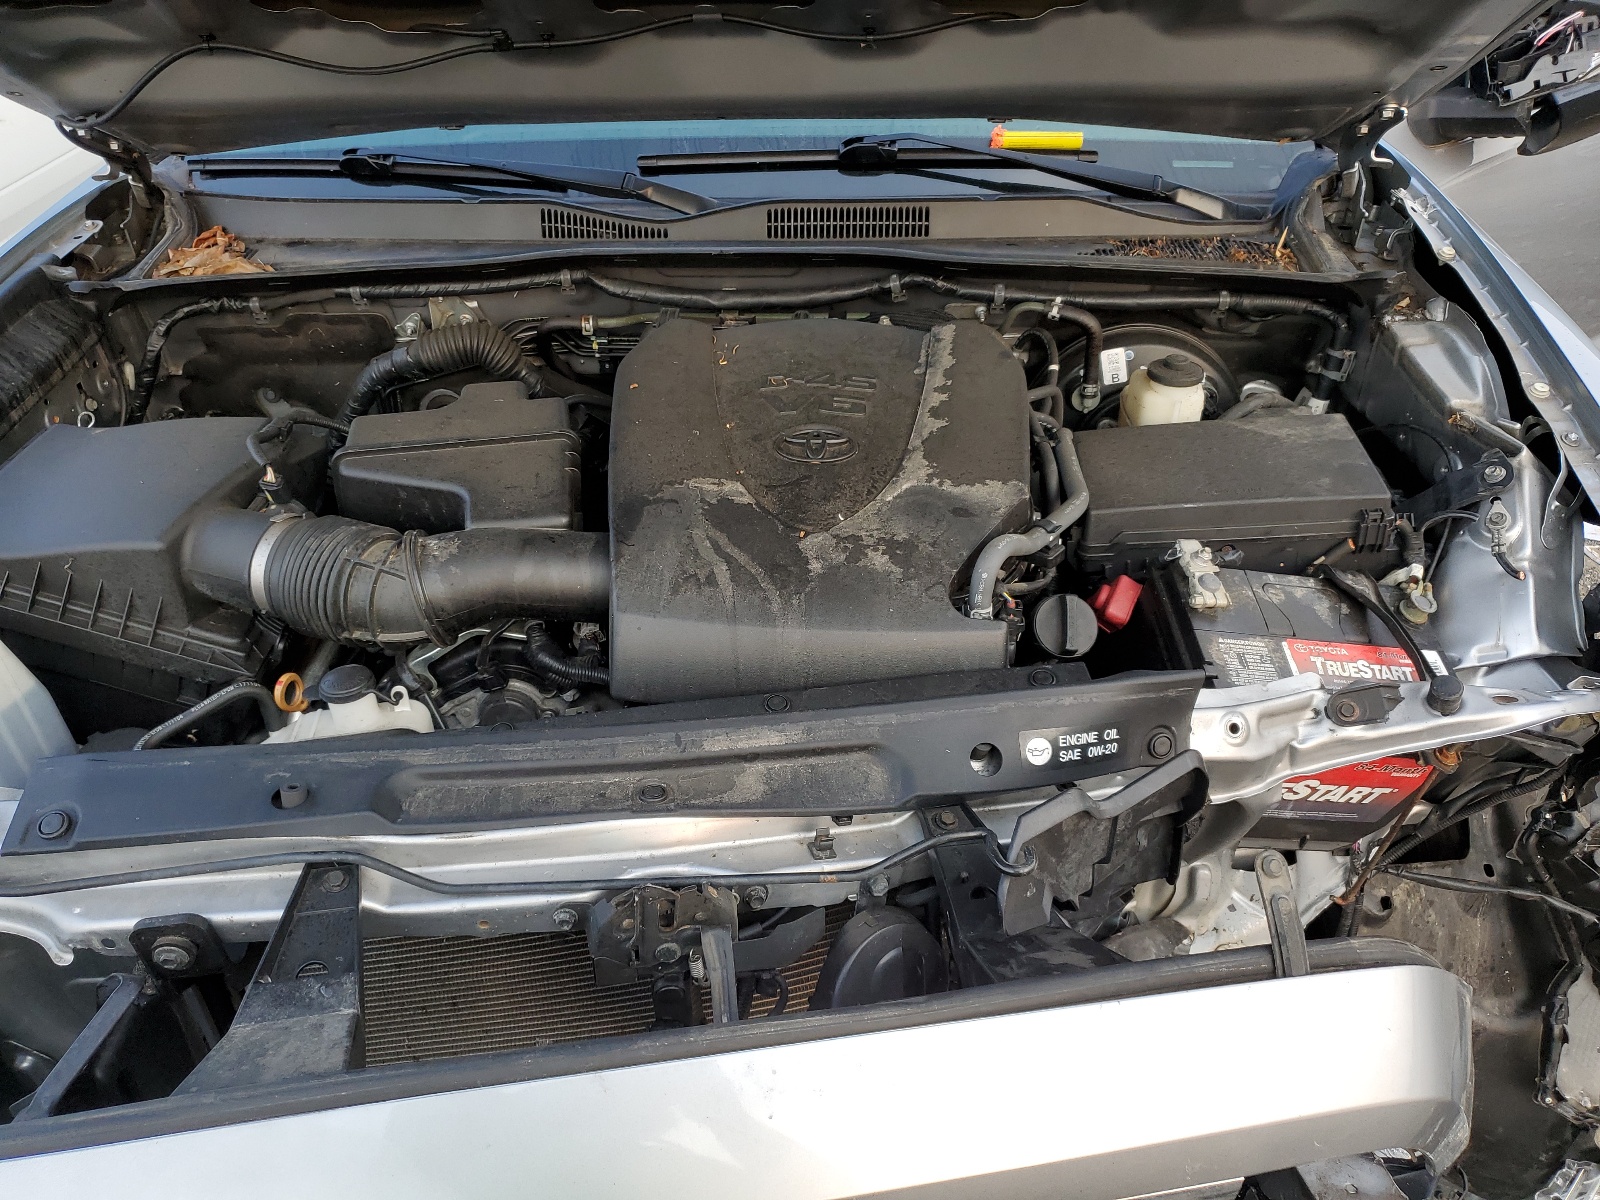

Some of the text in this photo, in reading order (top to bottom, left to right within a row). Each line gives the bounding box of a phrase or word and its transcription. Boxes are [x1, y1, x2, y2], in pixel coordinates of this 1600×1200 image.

[1111, 373, 1121, 383] B
[1308, 644, 1349, 656] TOYOTA
[1059, 728, 1120, 747] ENGINE OIL
[1059, 743, 1118, 762] SAE 0W-20
